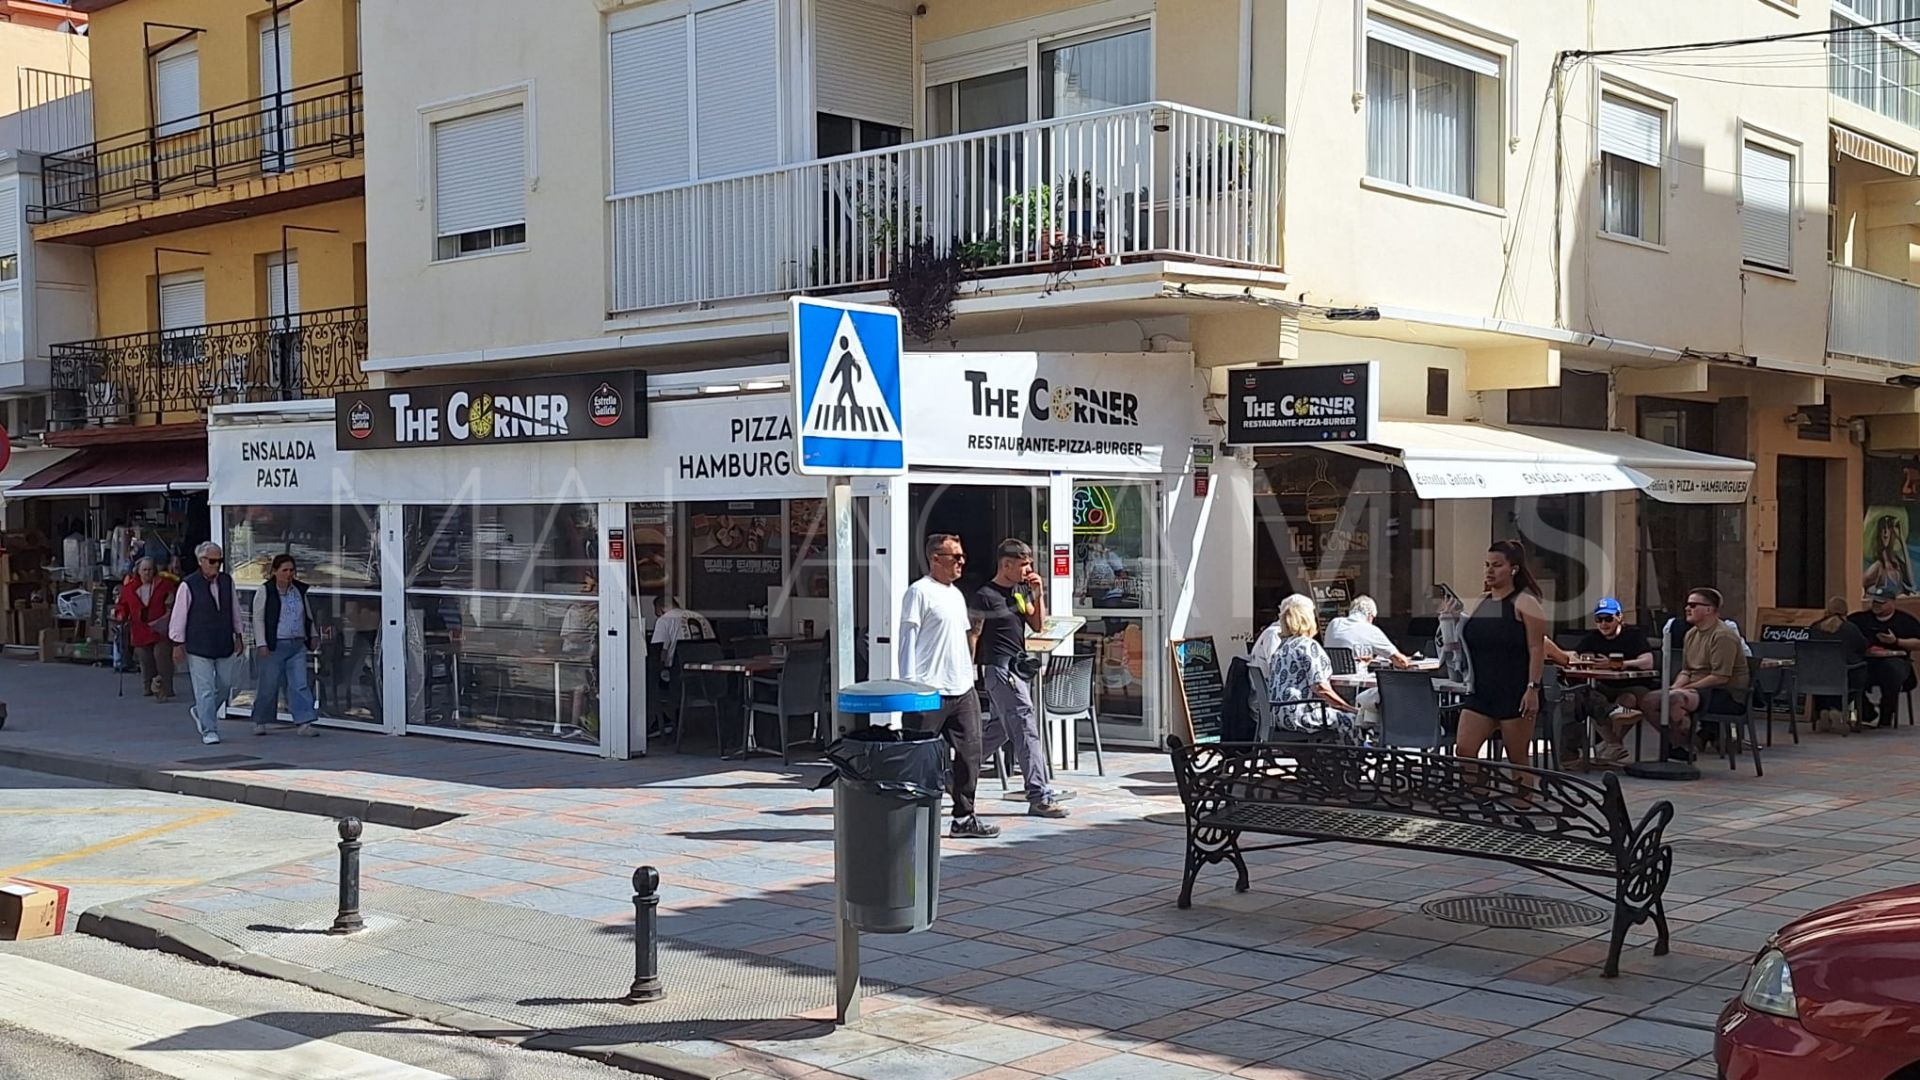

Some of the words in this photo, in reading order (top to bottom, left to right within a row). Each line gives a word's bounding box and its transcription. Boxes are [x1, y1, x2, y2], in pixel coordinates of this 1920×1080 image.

[731, 415, 793, 443] PIZZA
[242, 440, 316, 461] ENSALADA
[968, 434, 1143, 456] RESTAURANTE-PIZZA-BURGER
[680, 450, 793, 479] HAMBURG
[257, 468, 299, 487] PASTA
[1676, 480, 1694, 492] PIZZA
